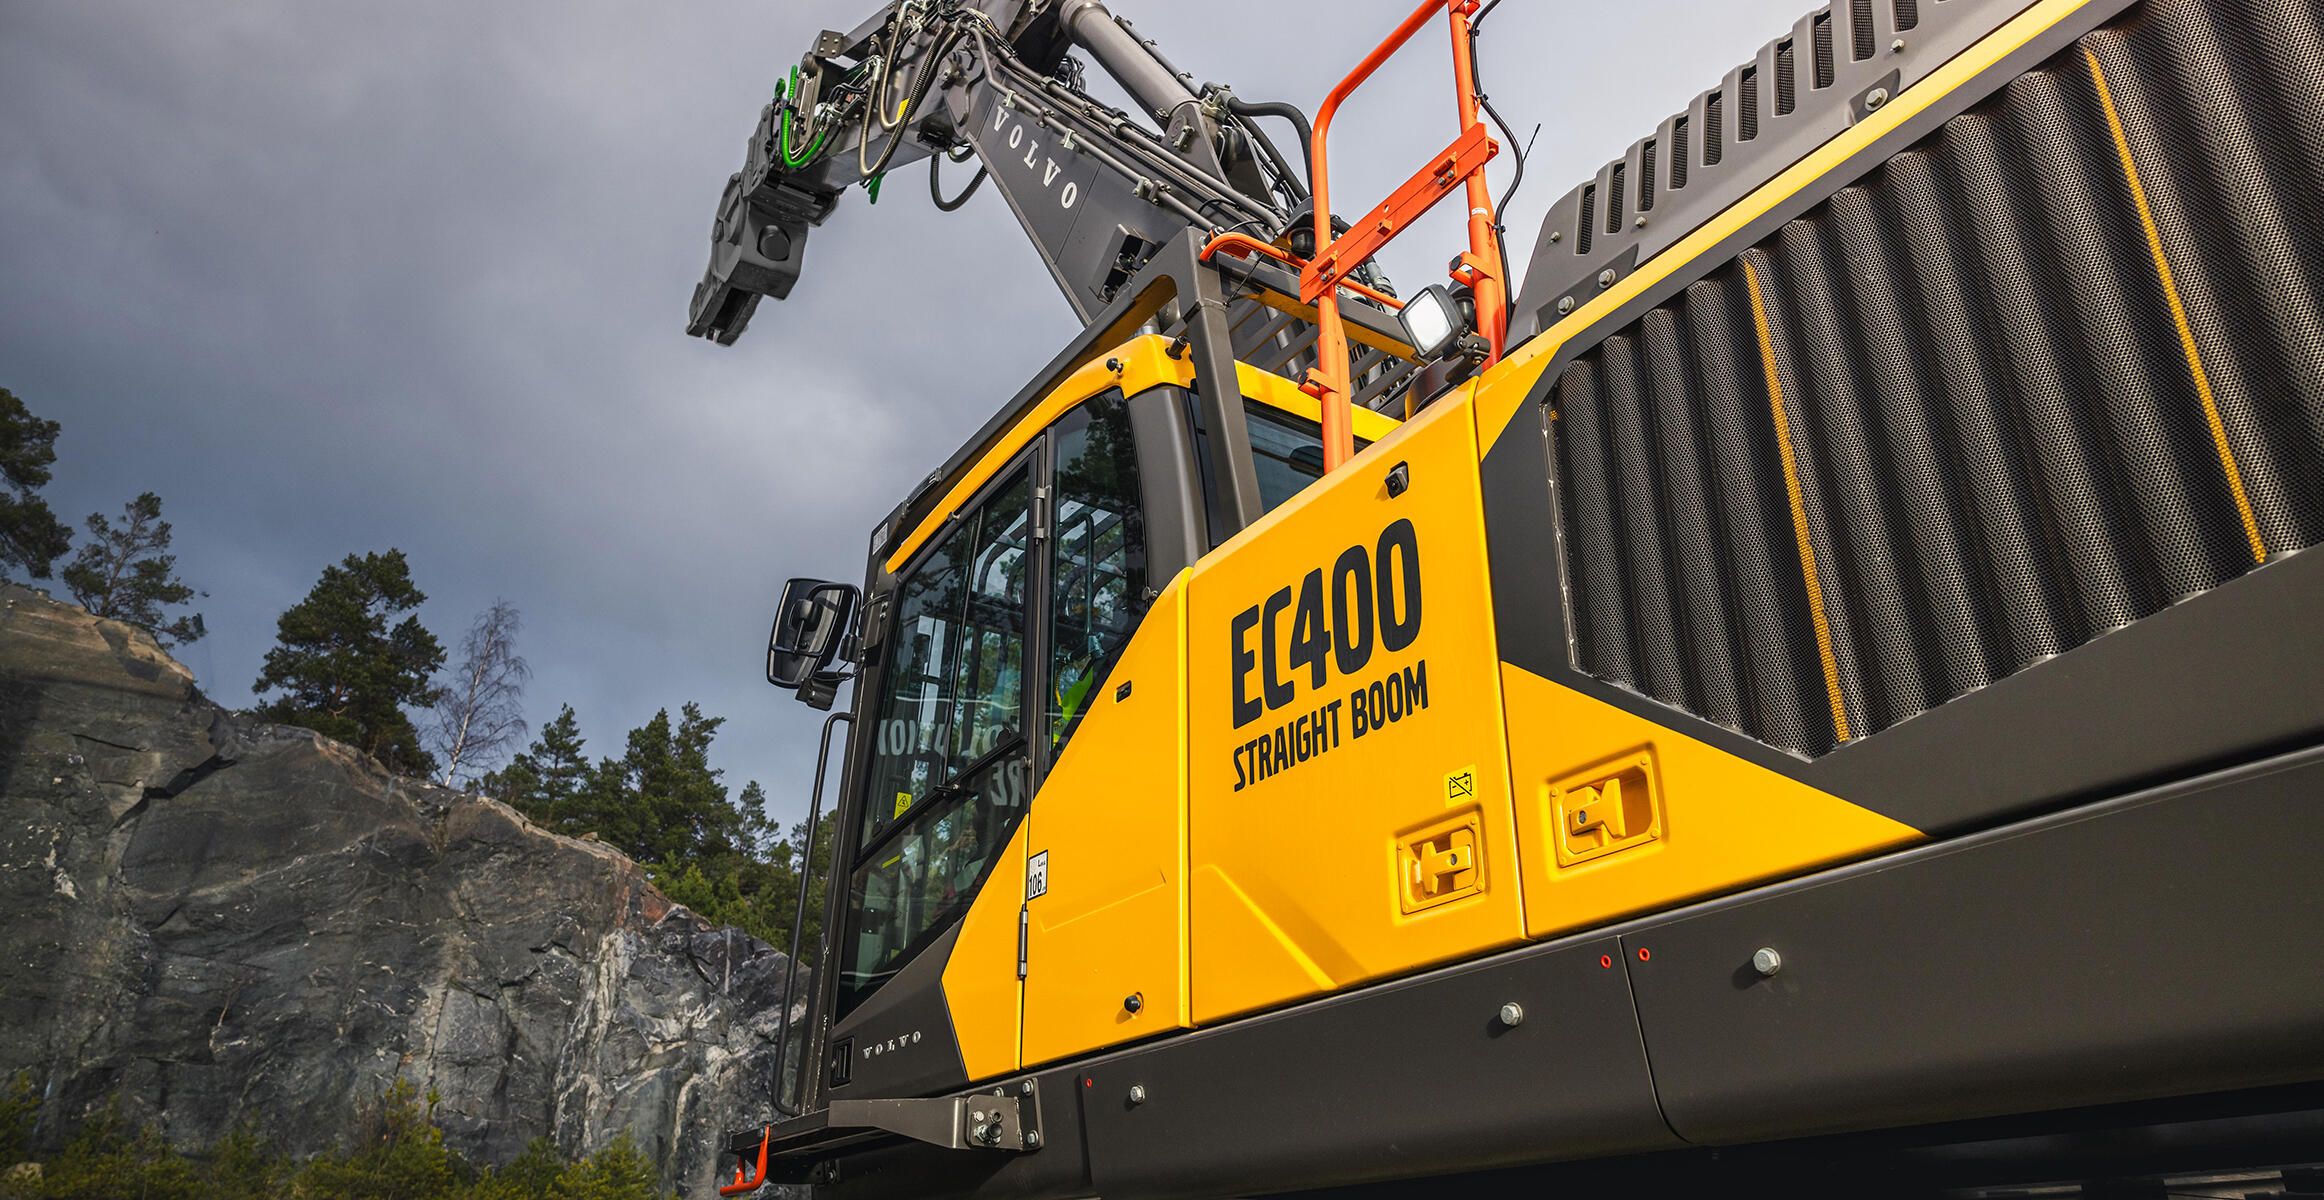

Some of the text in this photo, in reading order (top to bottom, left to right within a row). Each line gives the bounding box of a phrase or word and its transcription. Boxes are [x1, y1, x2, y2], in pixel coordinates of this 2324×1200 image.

[994, 105, 1078, 209] VOLVO
[1231, 518, 1422, 730] EC400
[1233, 659, 1429, 792] STRAIGHT BOOM
[1029, 871, 1043, 897] 106
[863, 1030, 921, 1059] VOLVO
